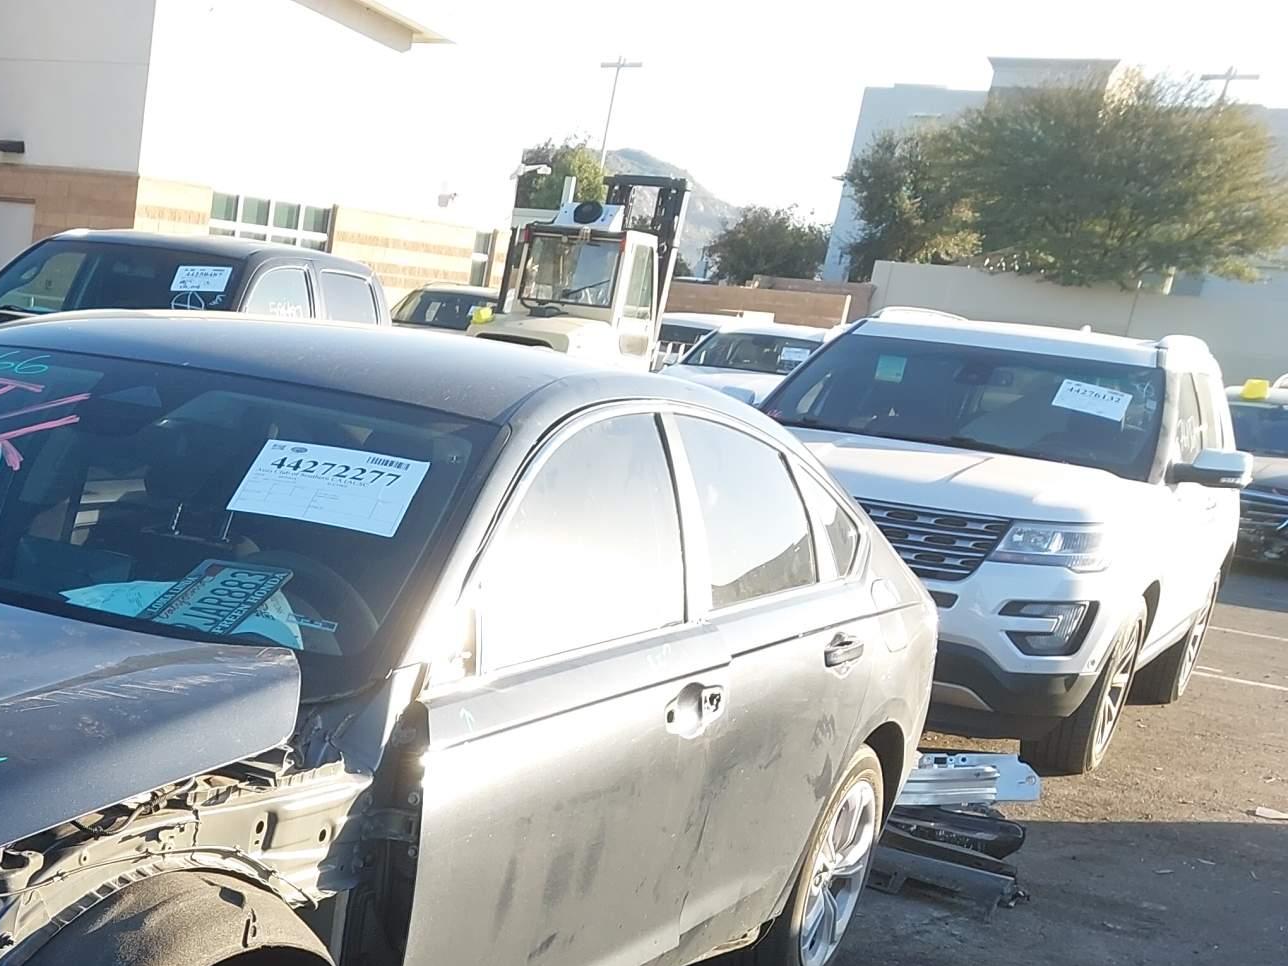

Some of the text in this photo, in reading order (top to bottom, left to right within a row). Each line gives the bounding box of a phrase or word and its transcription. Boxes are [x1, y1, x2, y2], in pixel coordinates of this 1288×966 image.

[270, 456, 401, 487] 44272277
[213, 603, 250, 634] PREEN
[248, 572, 287, 603] HONDA
